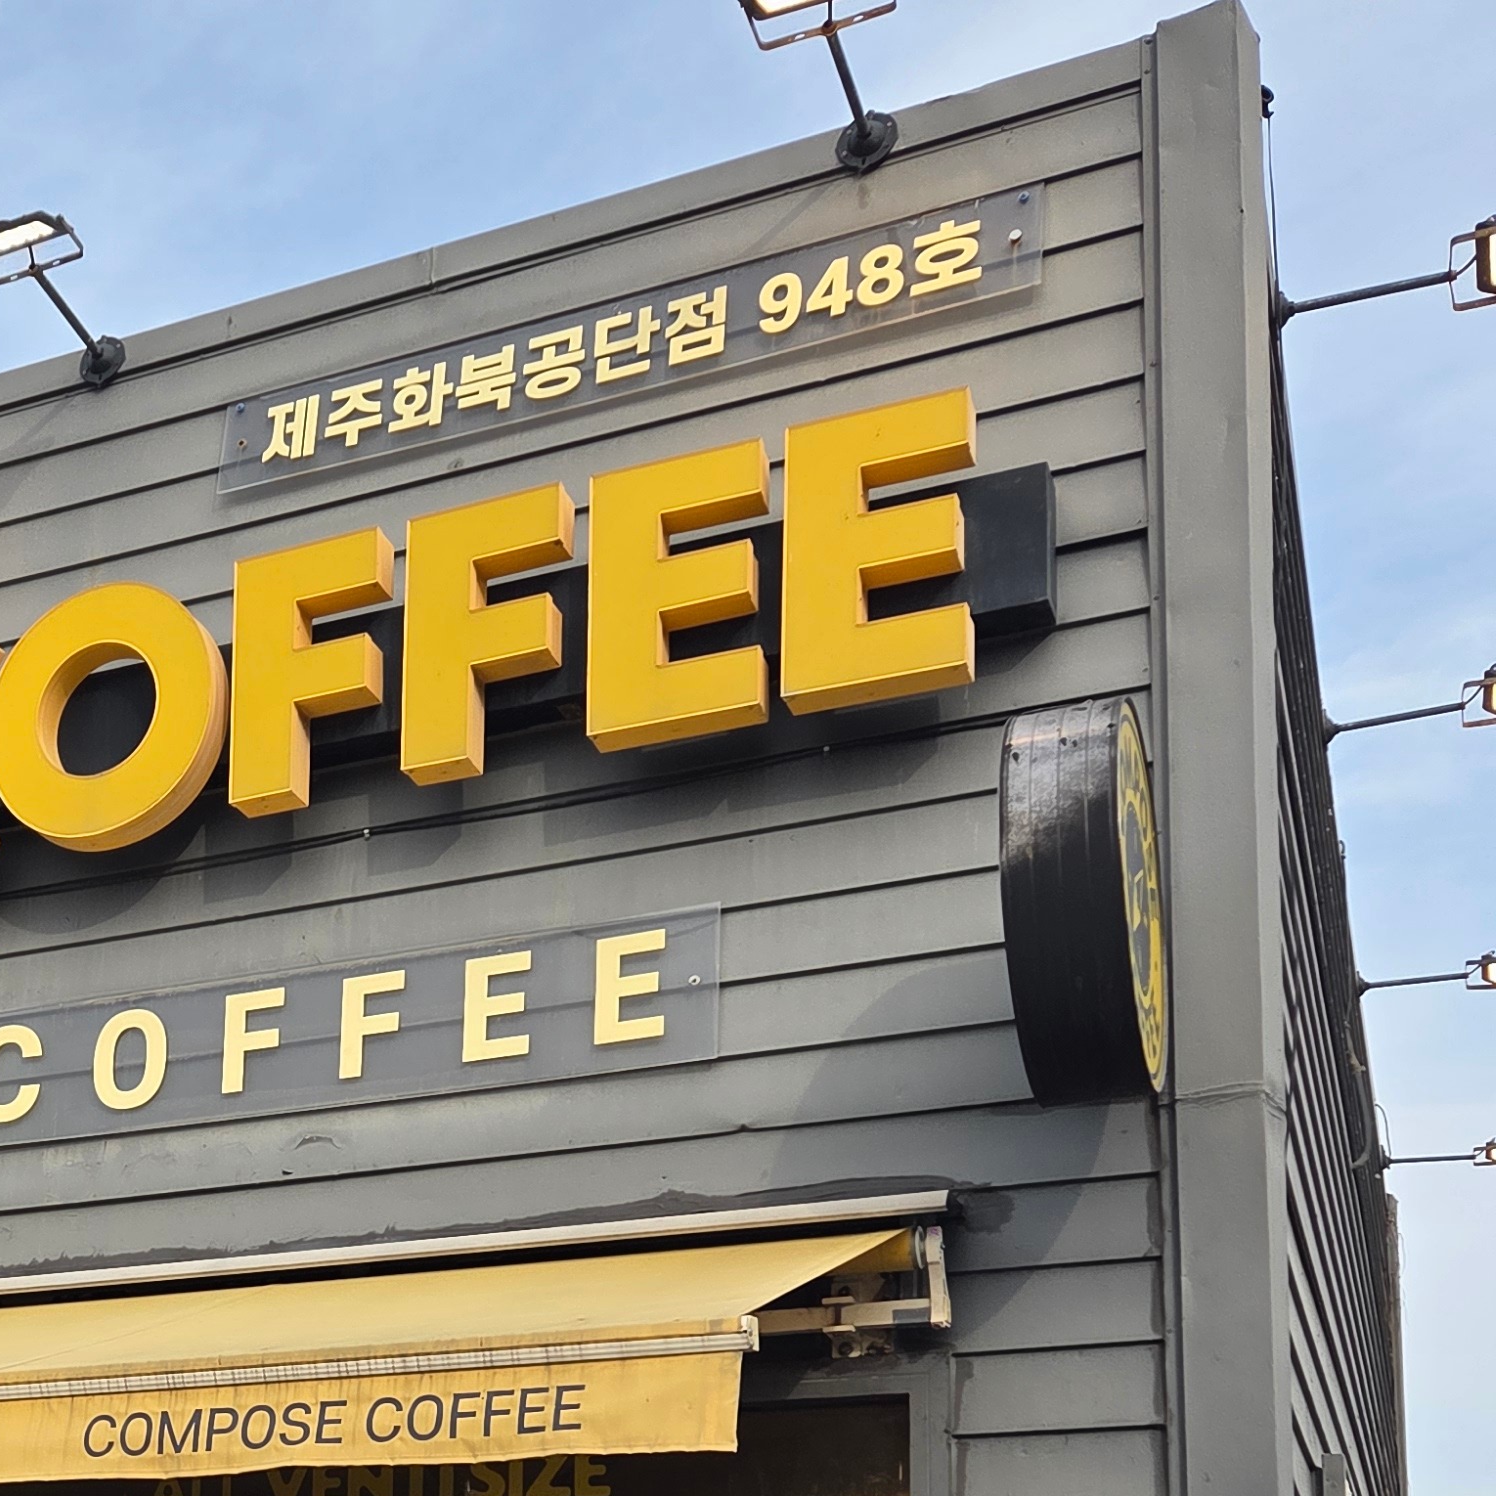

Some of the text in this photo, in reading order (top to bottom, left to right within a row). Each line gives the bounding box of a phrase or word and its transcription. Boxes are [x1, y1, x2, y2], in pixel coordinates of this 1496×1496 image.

[261, 219, 984, 465] 제주화북공단점 948호
[82, 1383, 587, 1459] COMPOSE COFFEE
